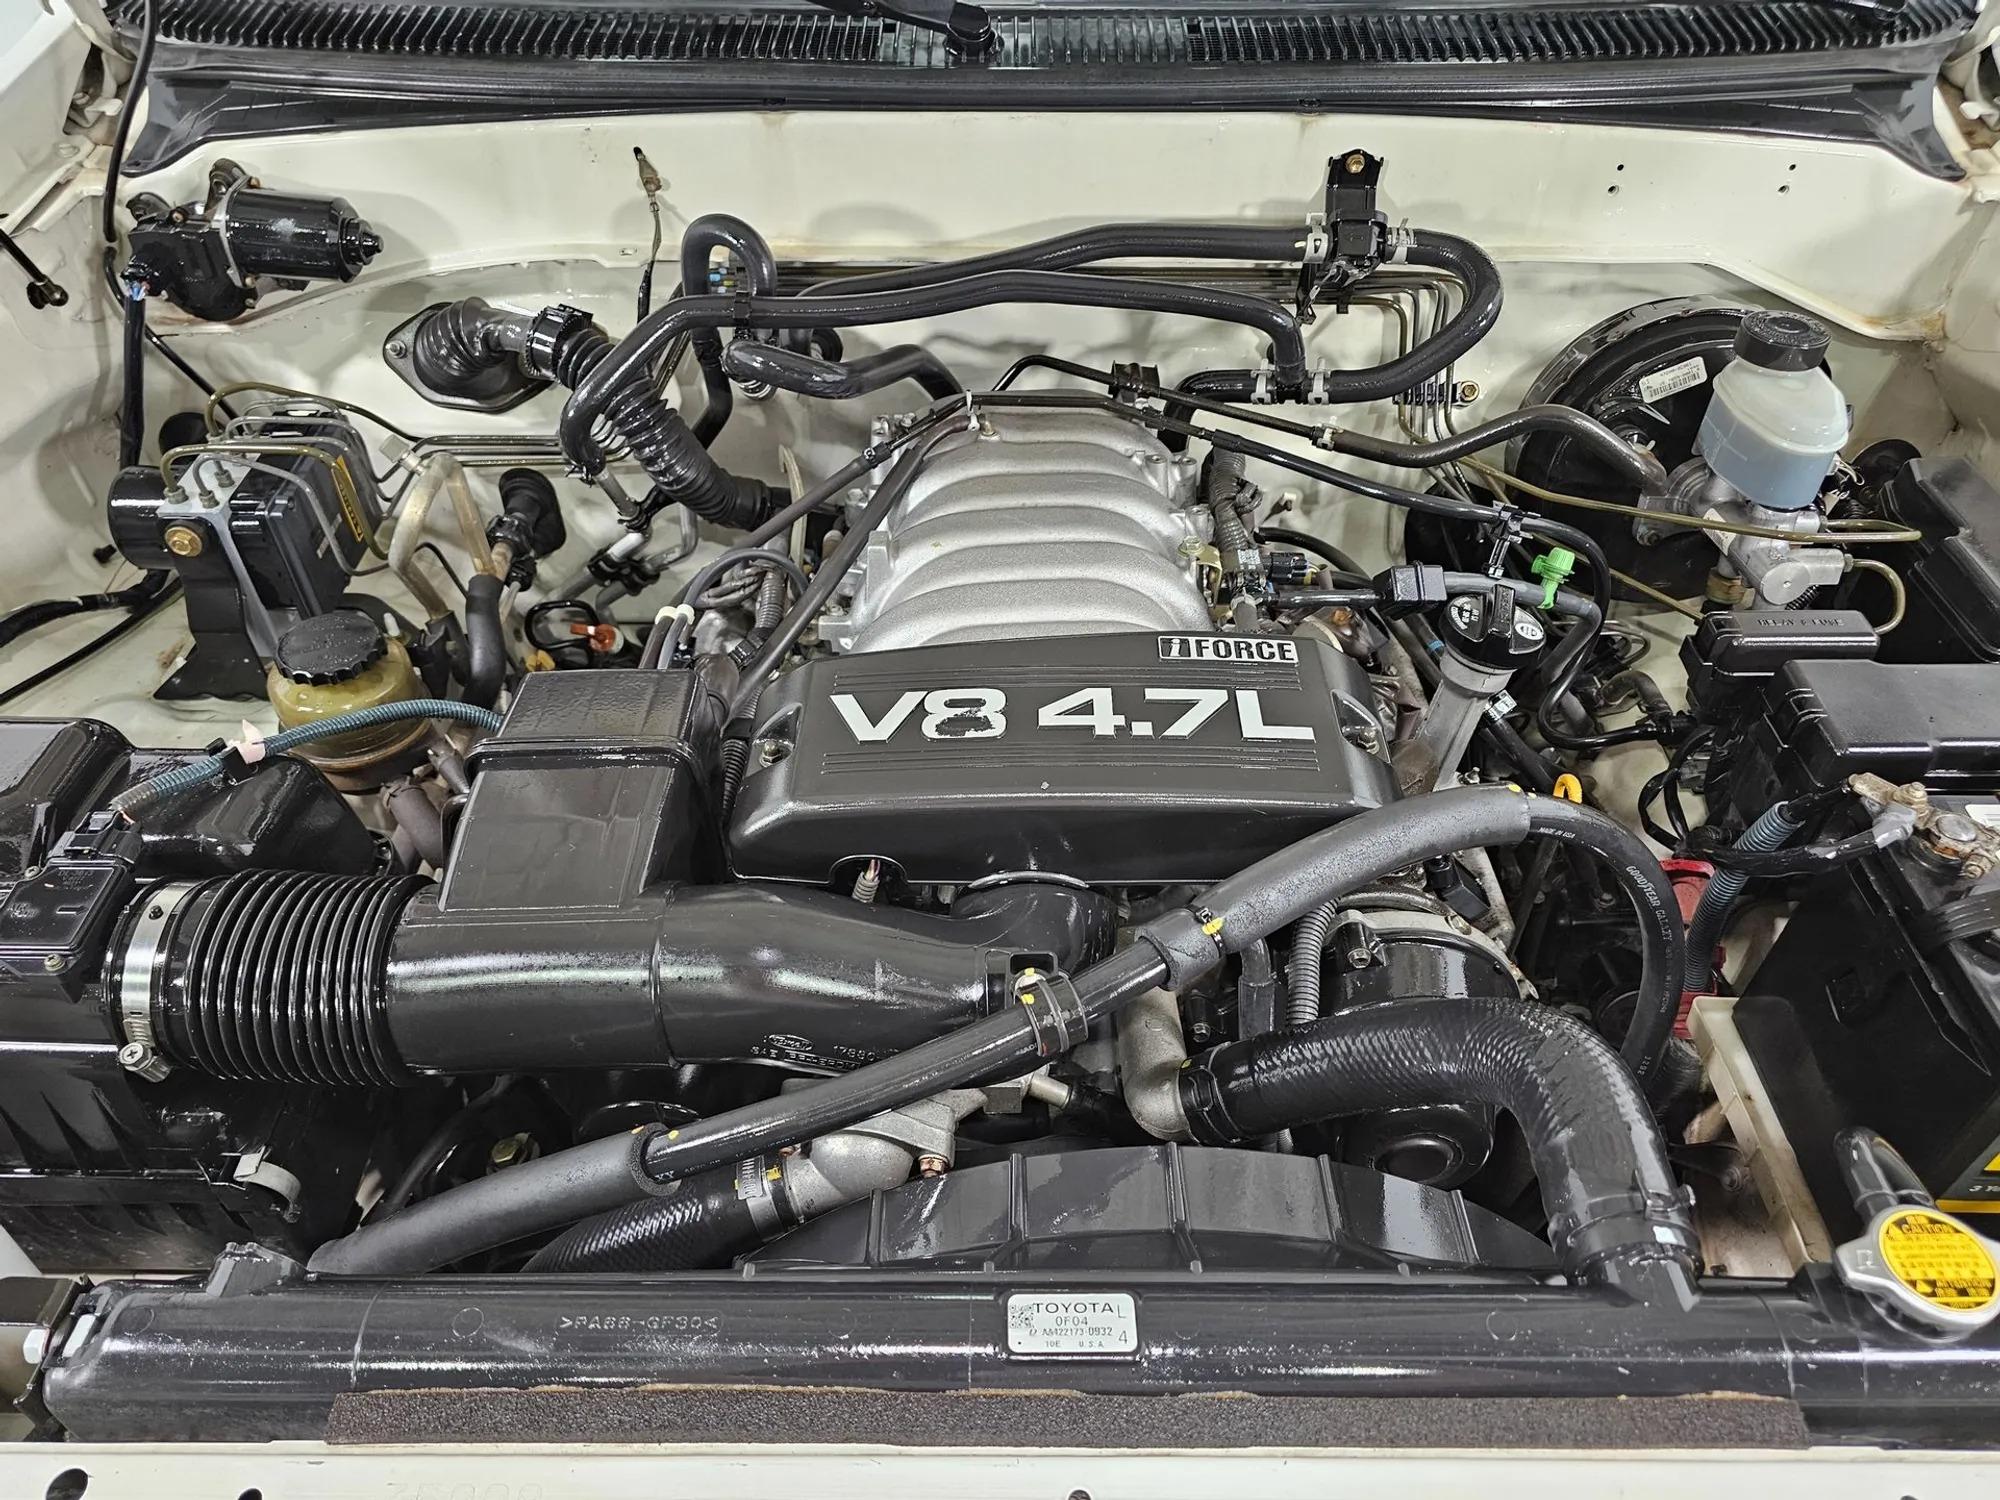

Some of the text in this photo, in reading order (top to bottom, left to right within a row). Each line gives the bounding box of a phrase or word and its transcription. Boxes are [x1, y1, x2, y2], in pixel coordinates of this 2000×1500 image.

[829, 687, 1316, 744] V8 4.7L
[1626, 865, 1661, 908] GOODYEAR
[1033, 1302, 1114, 1314] TOYOTA
[1117, 1304, 1127, 1319] L
[1118, 1330, 1128, 1345] 4
